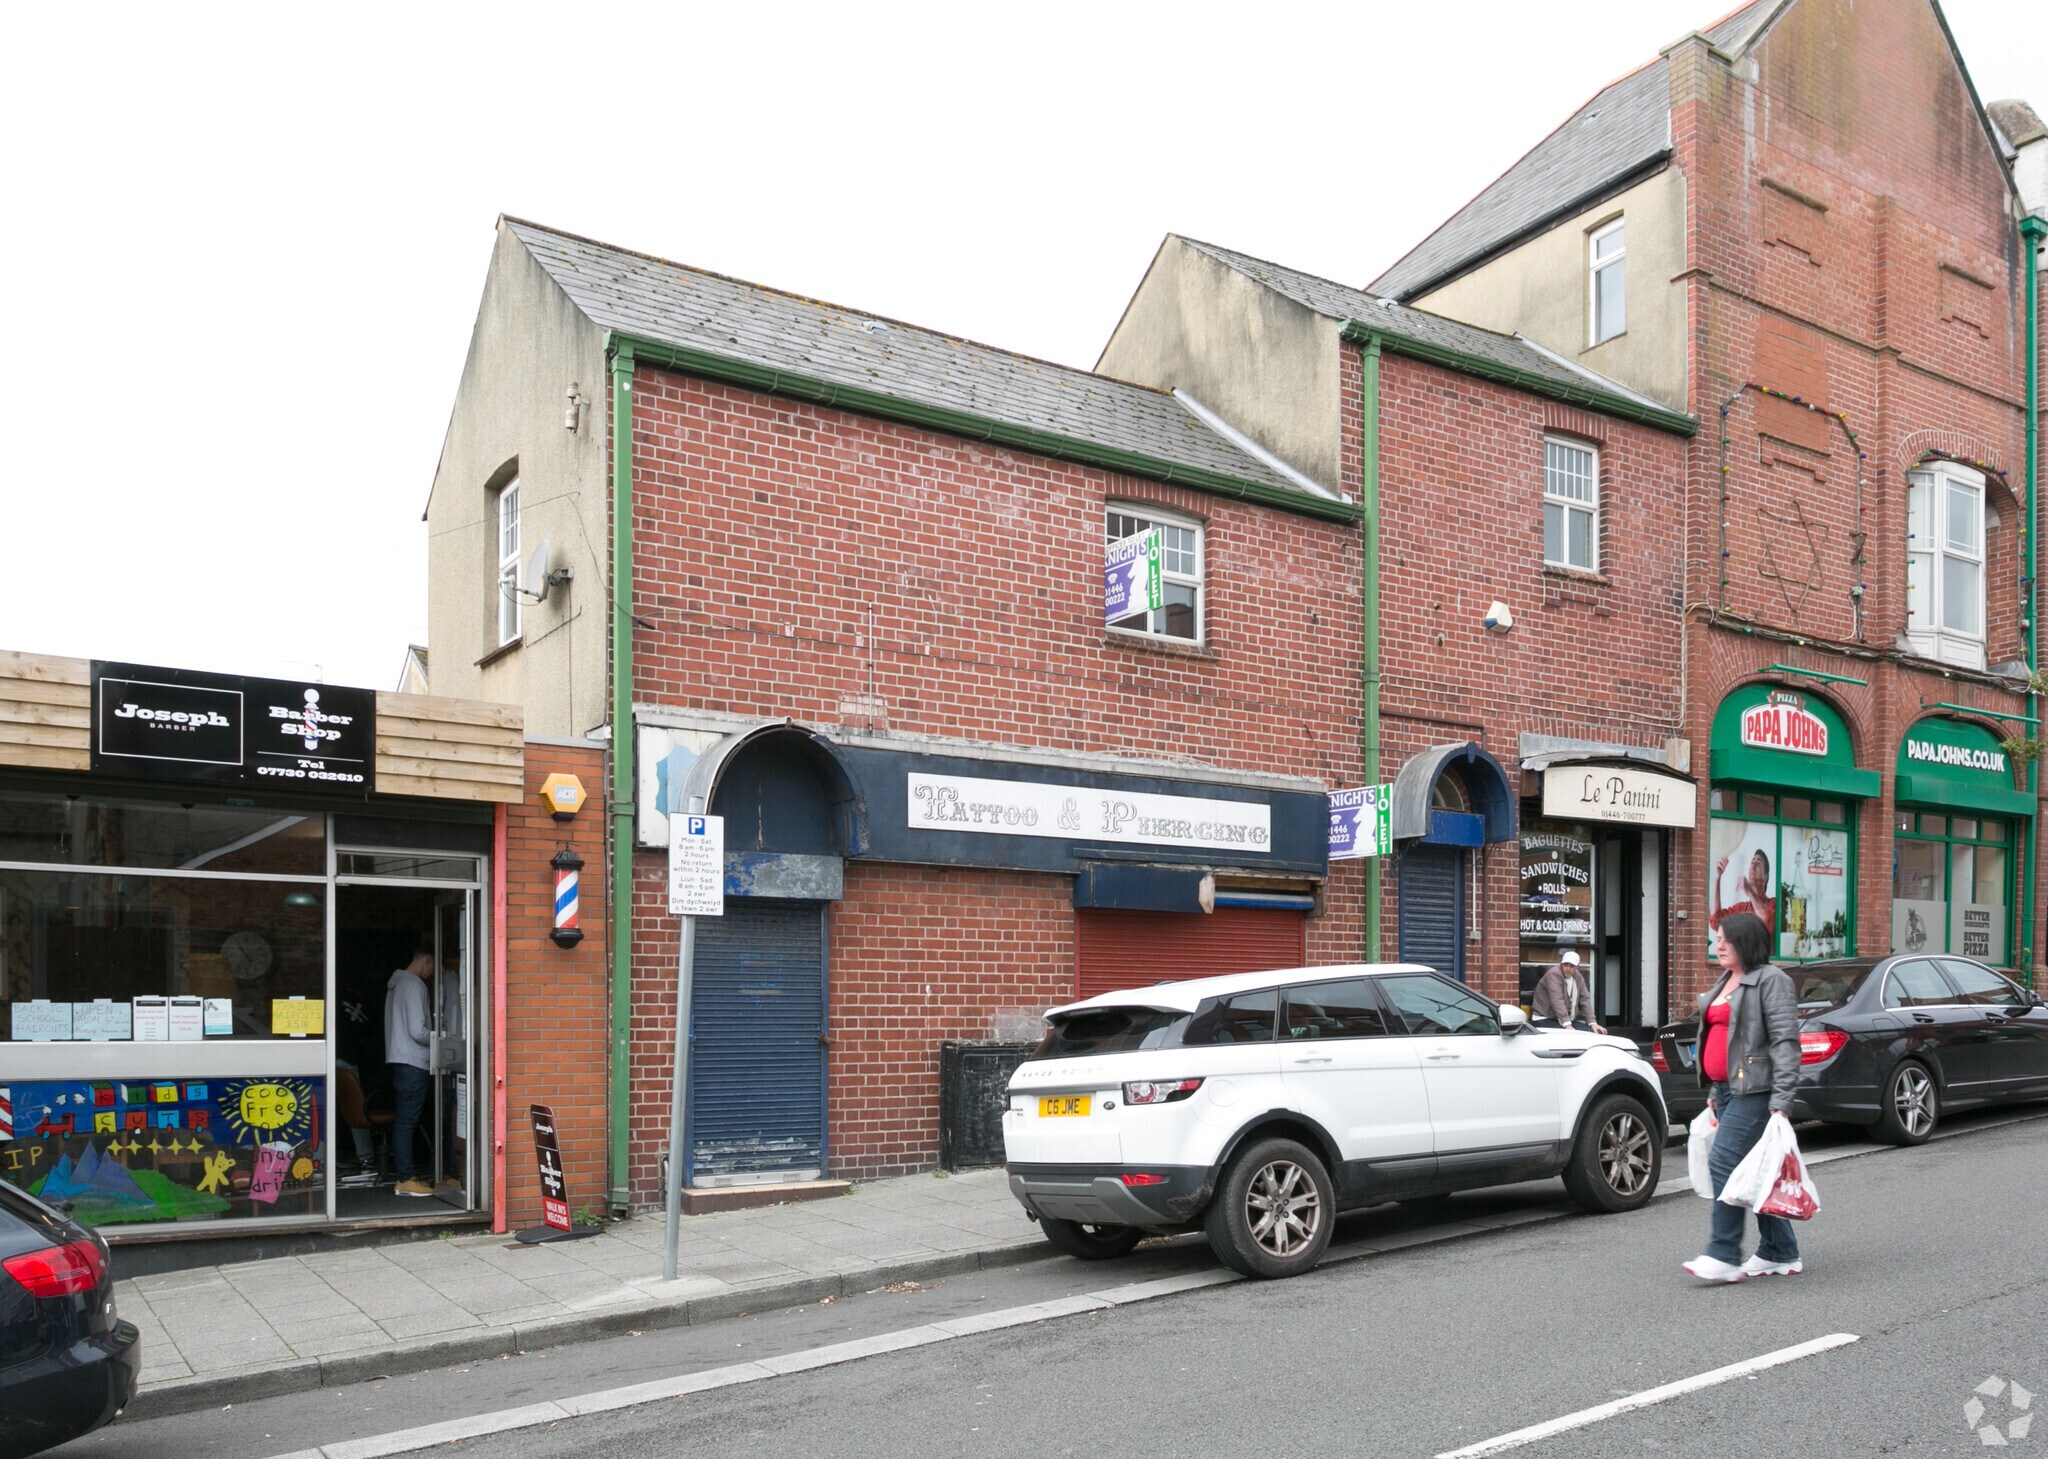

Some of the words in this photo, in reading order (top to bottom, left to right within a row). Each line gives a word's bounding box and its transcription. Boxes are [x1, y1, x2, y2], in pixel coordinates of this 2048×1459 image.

[1150, 532, 1159, 561] TO
[1776, 693, 1798, 706] PIZZA
[114, 703, 230, 727] Joseph
[268, 706, 353, 725] Barber
[150, 722, 196, 732] BARBER
[280, 722, 342, 741] Shop
[1746, 709, 1782, 743] PAPA
[1784, 710, 1826, 752] JOHNS
[298, 759, 325, 769] Tel
[1907, 740, 2005, 772] PAPAJOHNS.CO.UK
[257, 766, 305, 778] 07730
[308, 771, 364, 783] 032610
[556, 789, 576, 799] ADT
[1328, 789, 1375, 808] NIGHTS
[1378, 786, 1389, 811] TO
[1580, 774, 1601, 803] Le
[1606, 776, 1661, 809] Panini
[1058, 797, 1081, 830] &
[690, 818, 703, 834] P
[1328, 825, 1348, 835] 1446
[1524, 834, 1584, 855] BAGUETTES
[1520, 862, 1589, 884] SANDWICHES
[1542, 882, 1566, 895] ROLLS
[1964, 910, 1990, 922] BETTER
[1520, 920, 1535, 931] HOT
[1536, 920, 1542, 931] &
[1542, 920, 1562, 932] COLD
[1563, 920, 1589, 932] DRINKS
[1964, 932, 1990, 942] BETTER
[1963, 942, 1989, 956] PIZZA
[14, 1004, 45, 1014] BACK
[50, 1004, 63, 1013] TO
[81, 1004, 114, 1015] OPEN
[18, 1014, 62, 1023] SCHOOL
[16, 1024, 70, 1033] HAIRCUTS
[1046, 1099, 1059, 1115] C6
[1062, 1098, 1081, 1115] JME
[546, 1200, 558, 1211] WALK
[546, 1211, 569, 1227] WELCOME
